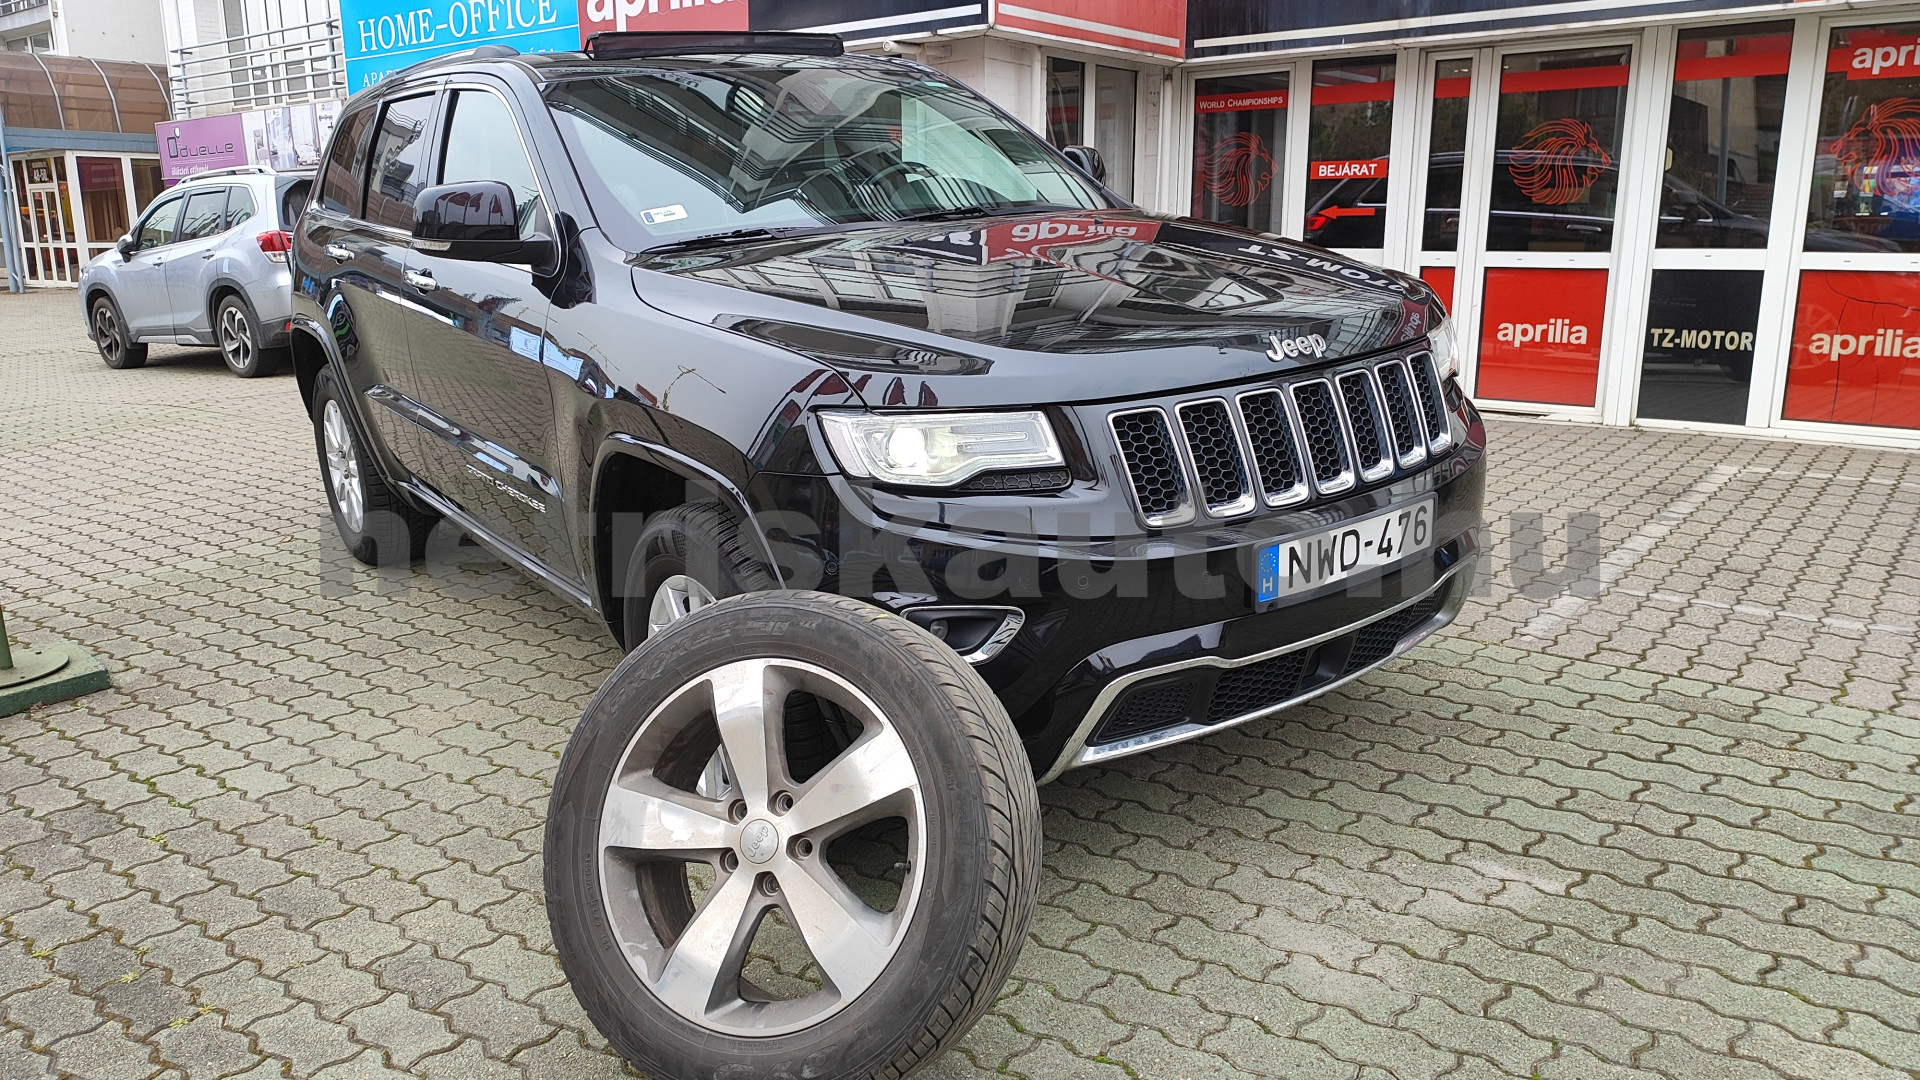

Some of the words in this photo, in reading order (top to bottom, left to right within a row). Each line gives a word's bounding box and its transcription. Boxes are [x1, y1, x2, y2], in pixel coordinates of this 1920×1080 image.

[357, 0, 558, 52] HOME-OFFICE
[1318, 162, 1378, 178] BEJÁRAT
[1265, 333, 1327, 362] Jeep
[1496, 319, 1587, 348] aprilia
[1650, 328, 1753, 351] TZ-MOTOR
[1288, 505, 1428, 589] NWD-476
[1262, 576, 1273, 594] H
[747, 825, 769, 857] Jeep
